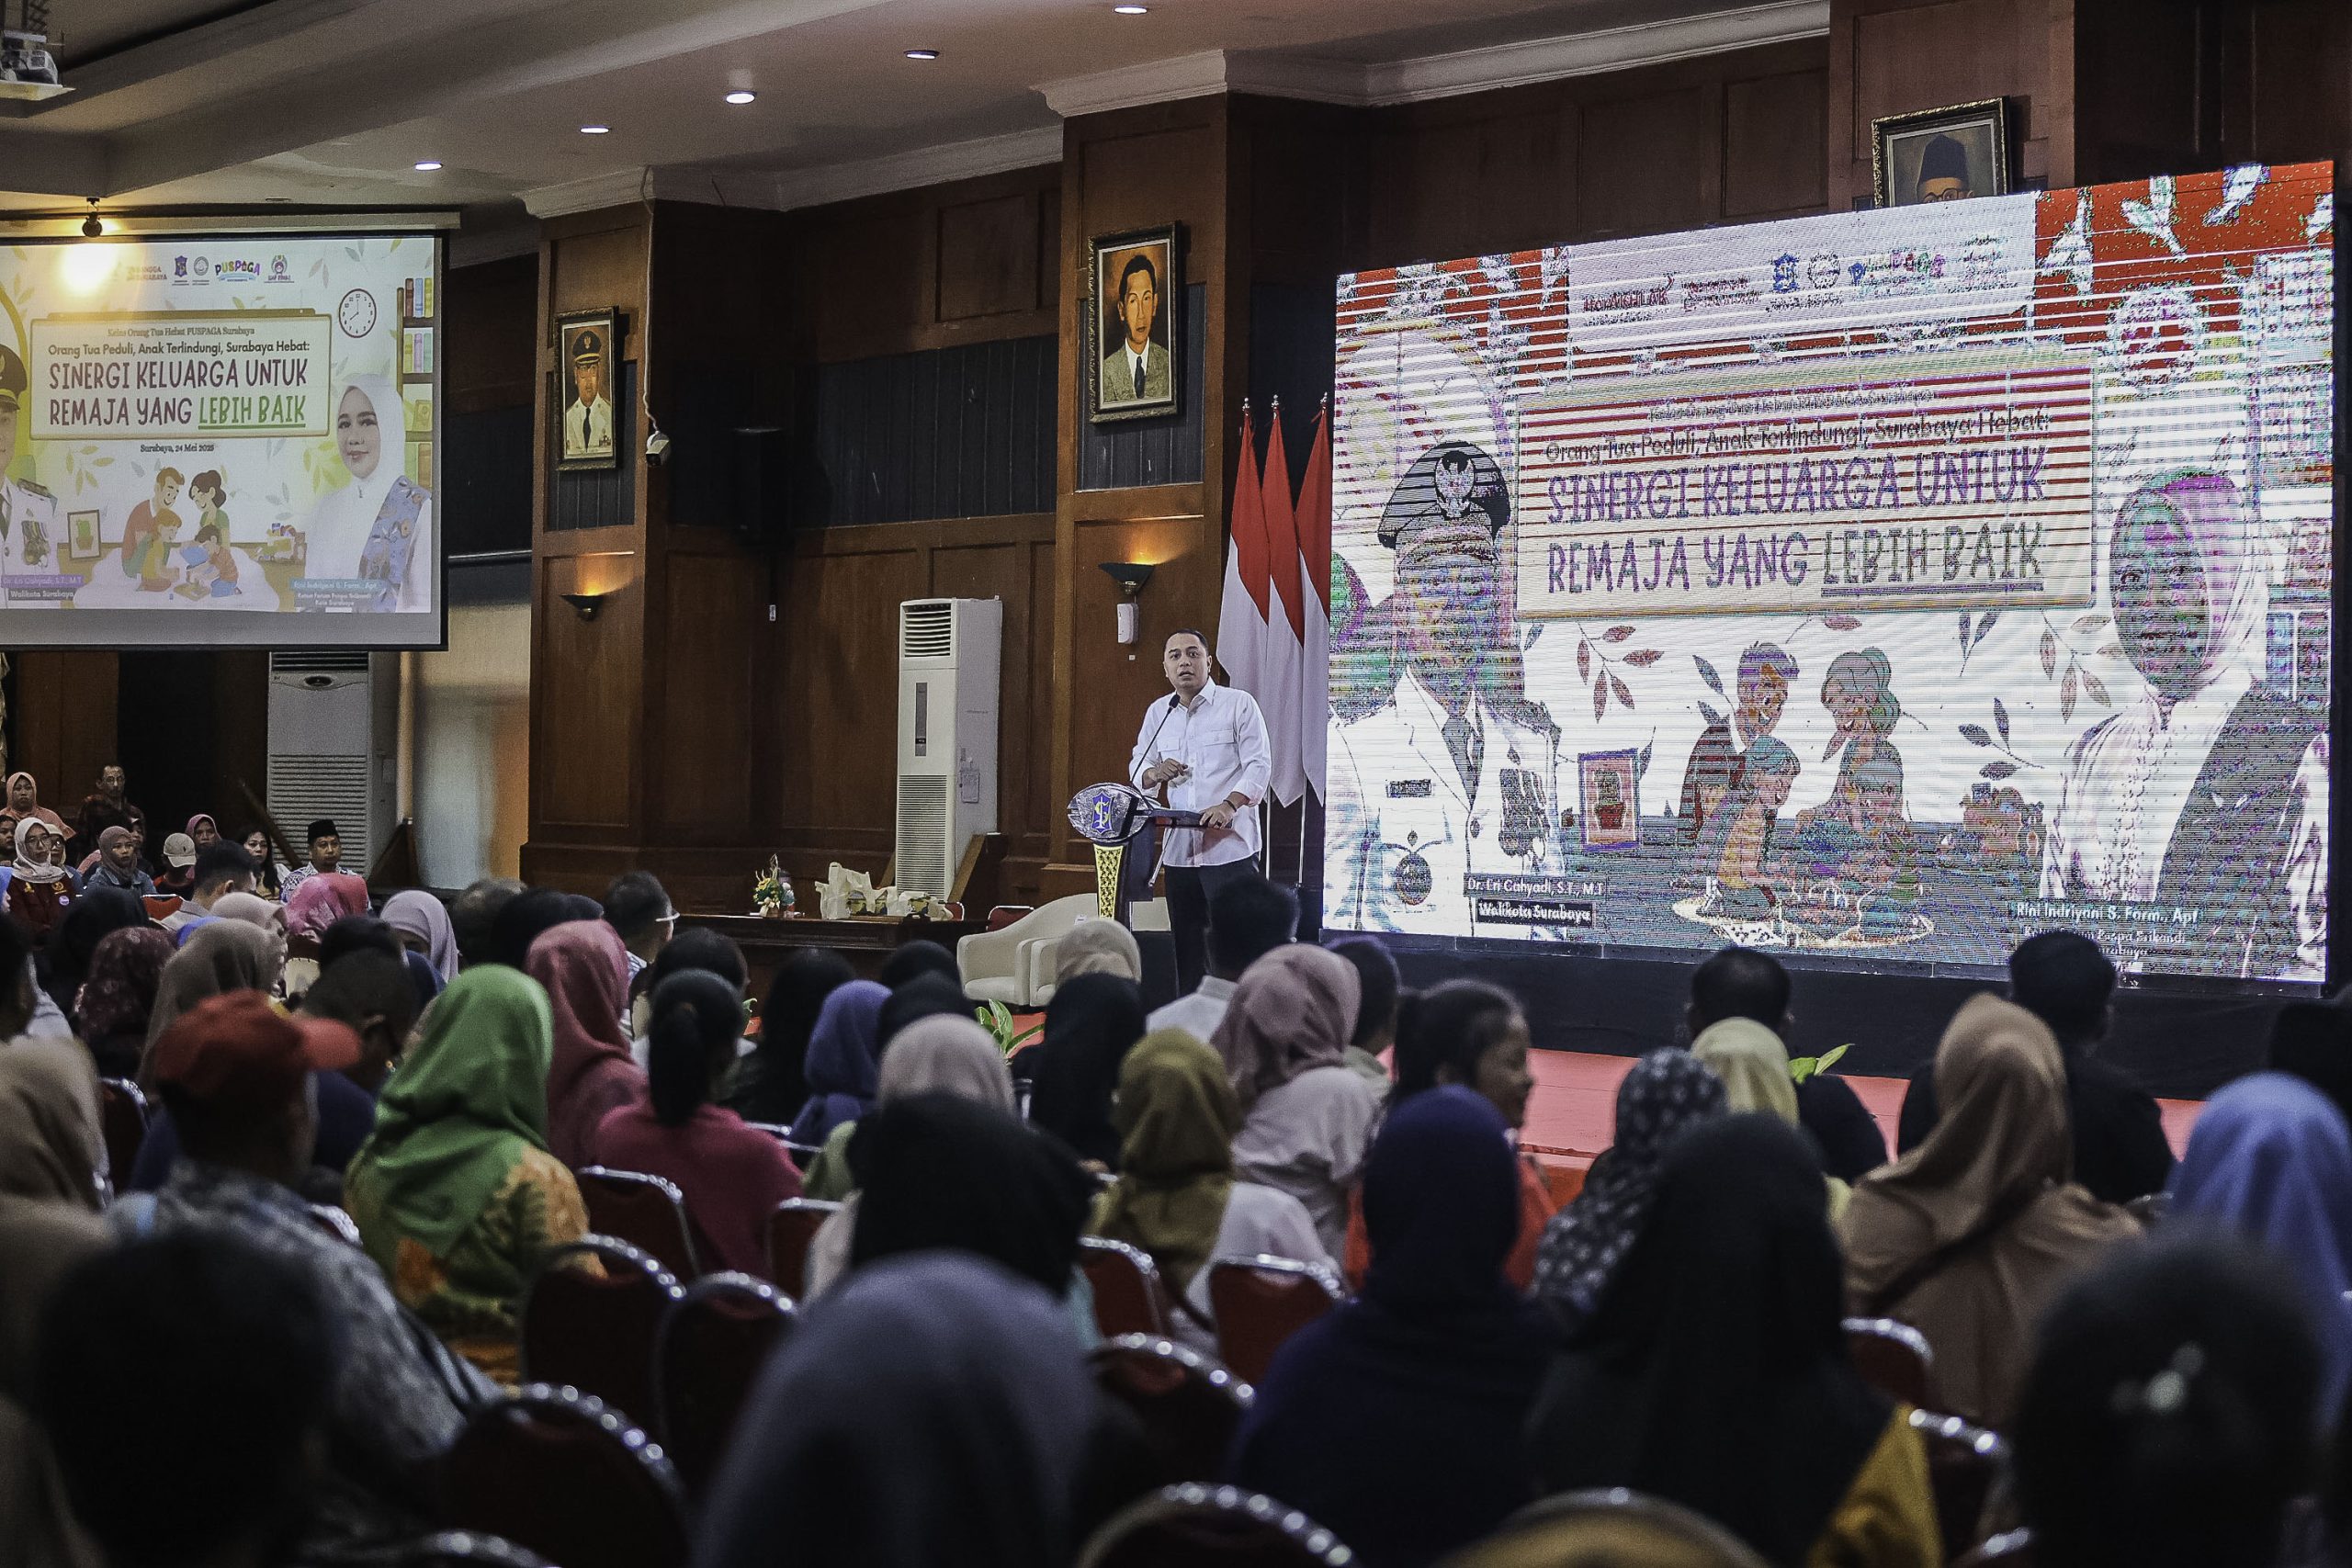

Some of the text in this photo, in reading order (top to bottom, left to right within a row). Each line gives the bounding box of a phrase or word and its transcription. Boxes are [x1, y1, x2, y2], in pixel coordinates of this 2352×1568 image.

[215, 260, 260, 276] PUSPAGA
[49, 339, 310, 359] Orang Tua Peduli, Anak Terlindungi, Surabaya Hebat:
[49, 358, 308, 389] SINERGI KELUARGA UNTUK
[50, 394, 307, 426] REMAJA YANG LEBIH BAIK
[1642, 429, 1701, 457] Peduli,
[1706, 424, 1754, 453] Anak
[1547, 445, 2047, 525] SINERGI KELUARGA UNTUK
[1548, 521, 2044, 593] REMAJA YANG LEBIH BAIK
[1504, 878, 1555, 897] Cahyadi,
[1478, 901, 1592, 923] Walikota Surabaya
[2017, 903, 2041, 918] Rini
[2045, 902, 2103, 923] Indriyani
